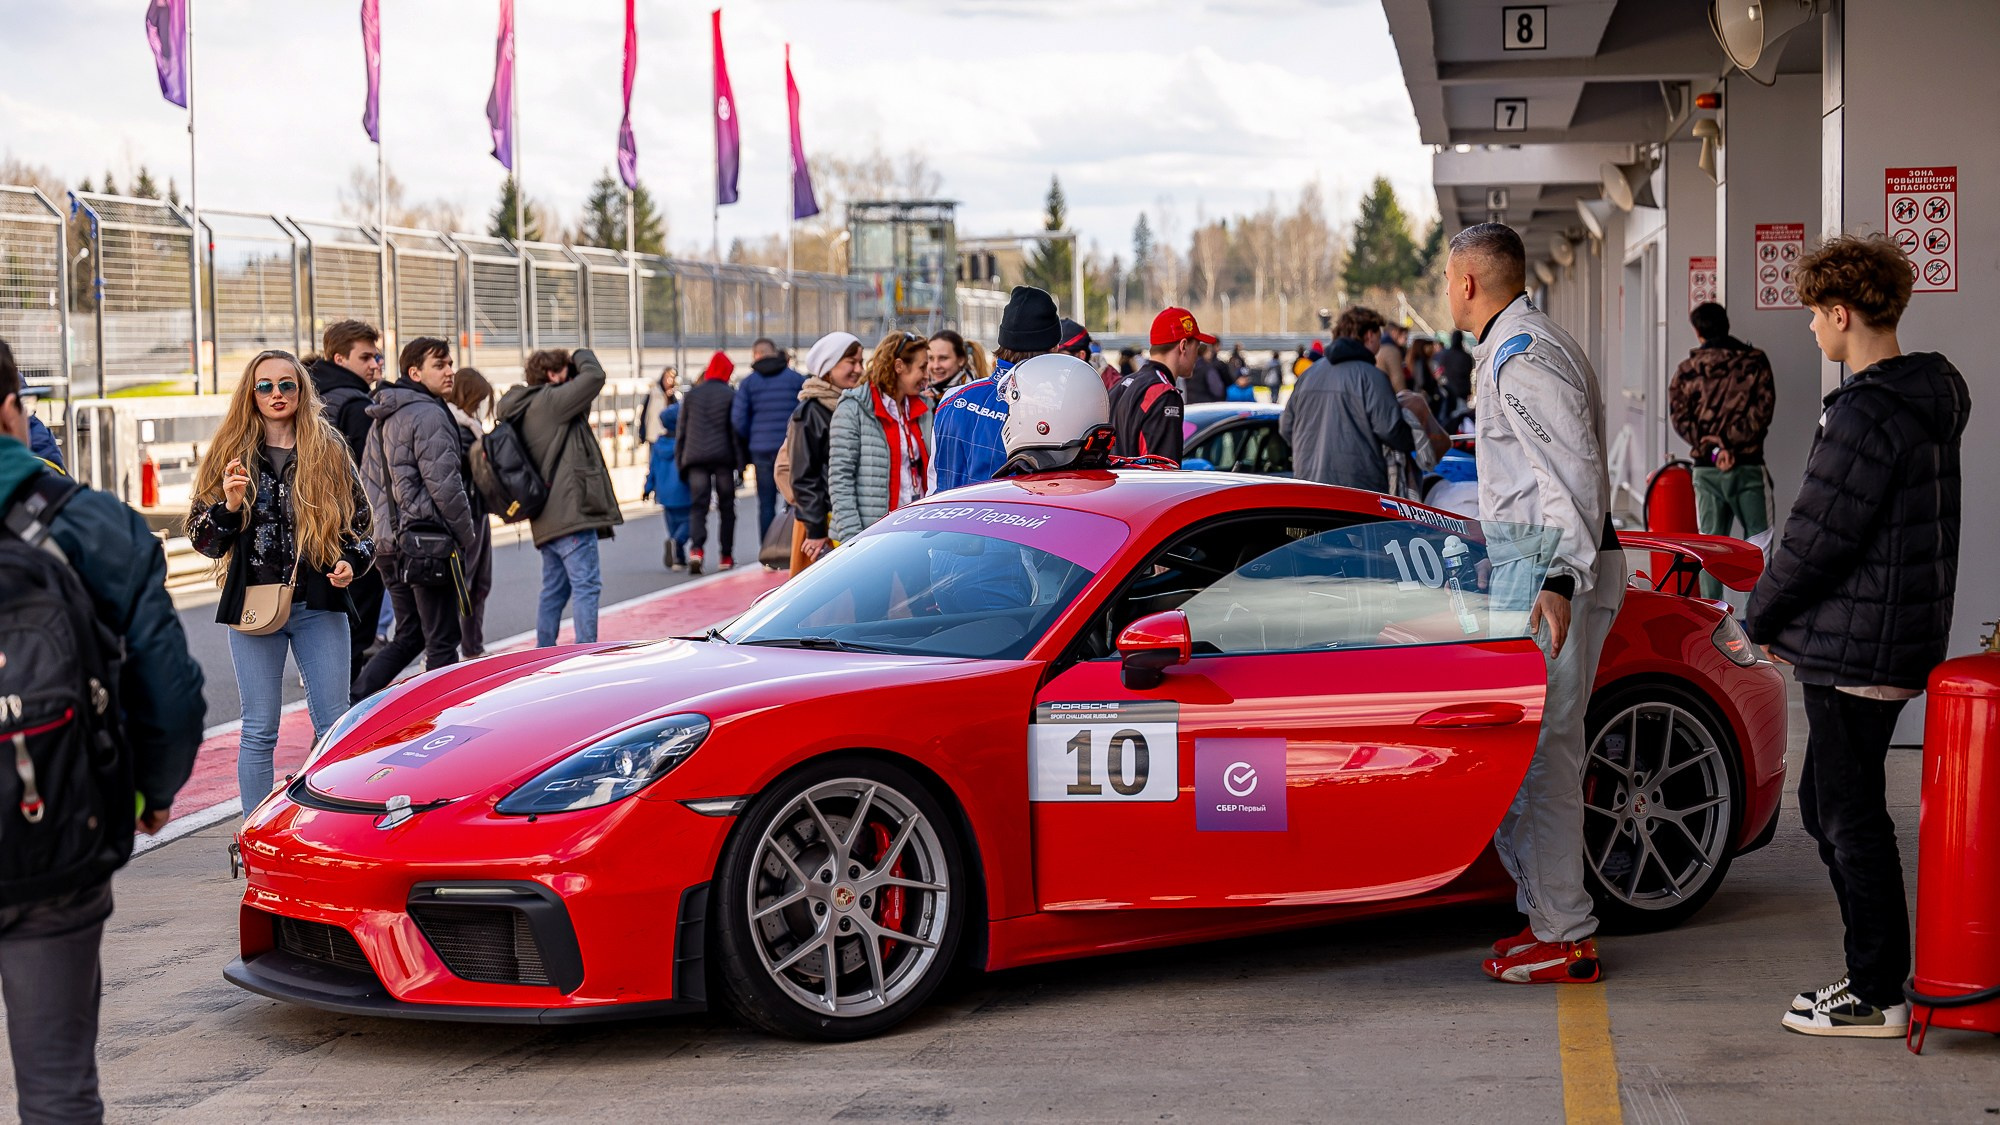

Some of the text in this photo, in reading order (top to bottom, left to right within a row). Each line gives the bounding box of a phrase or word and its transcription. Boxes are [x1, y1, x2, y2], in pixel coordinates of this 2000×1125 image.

[1517, 13, 1533, 43] 8
[1505, 105, 1517, 127] 7
[1887, 175, 1955, 184] ПОВЫШЕННОЙ
[1893, 183, 1951, 191] ОПАСНОСТИ
[966, 402, 1008, 422] SUBAR
[1505, 394, 1551, 443] alpinestars
[918, 507, 1051, 529] СБЕР Первый
[1384, 537, 1444, 591] 10
[1066, 729, 1150, 796] 10
[1216, 804, 1267, 812] СБЕР Первый
